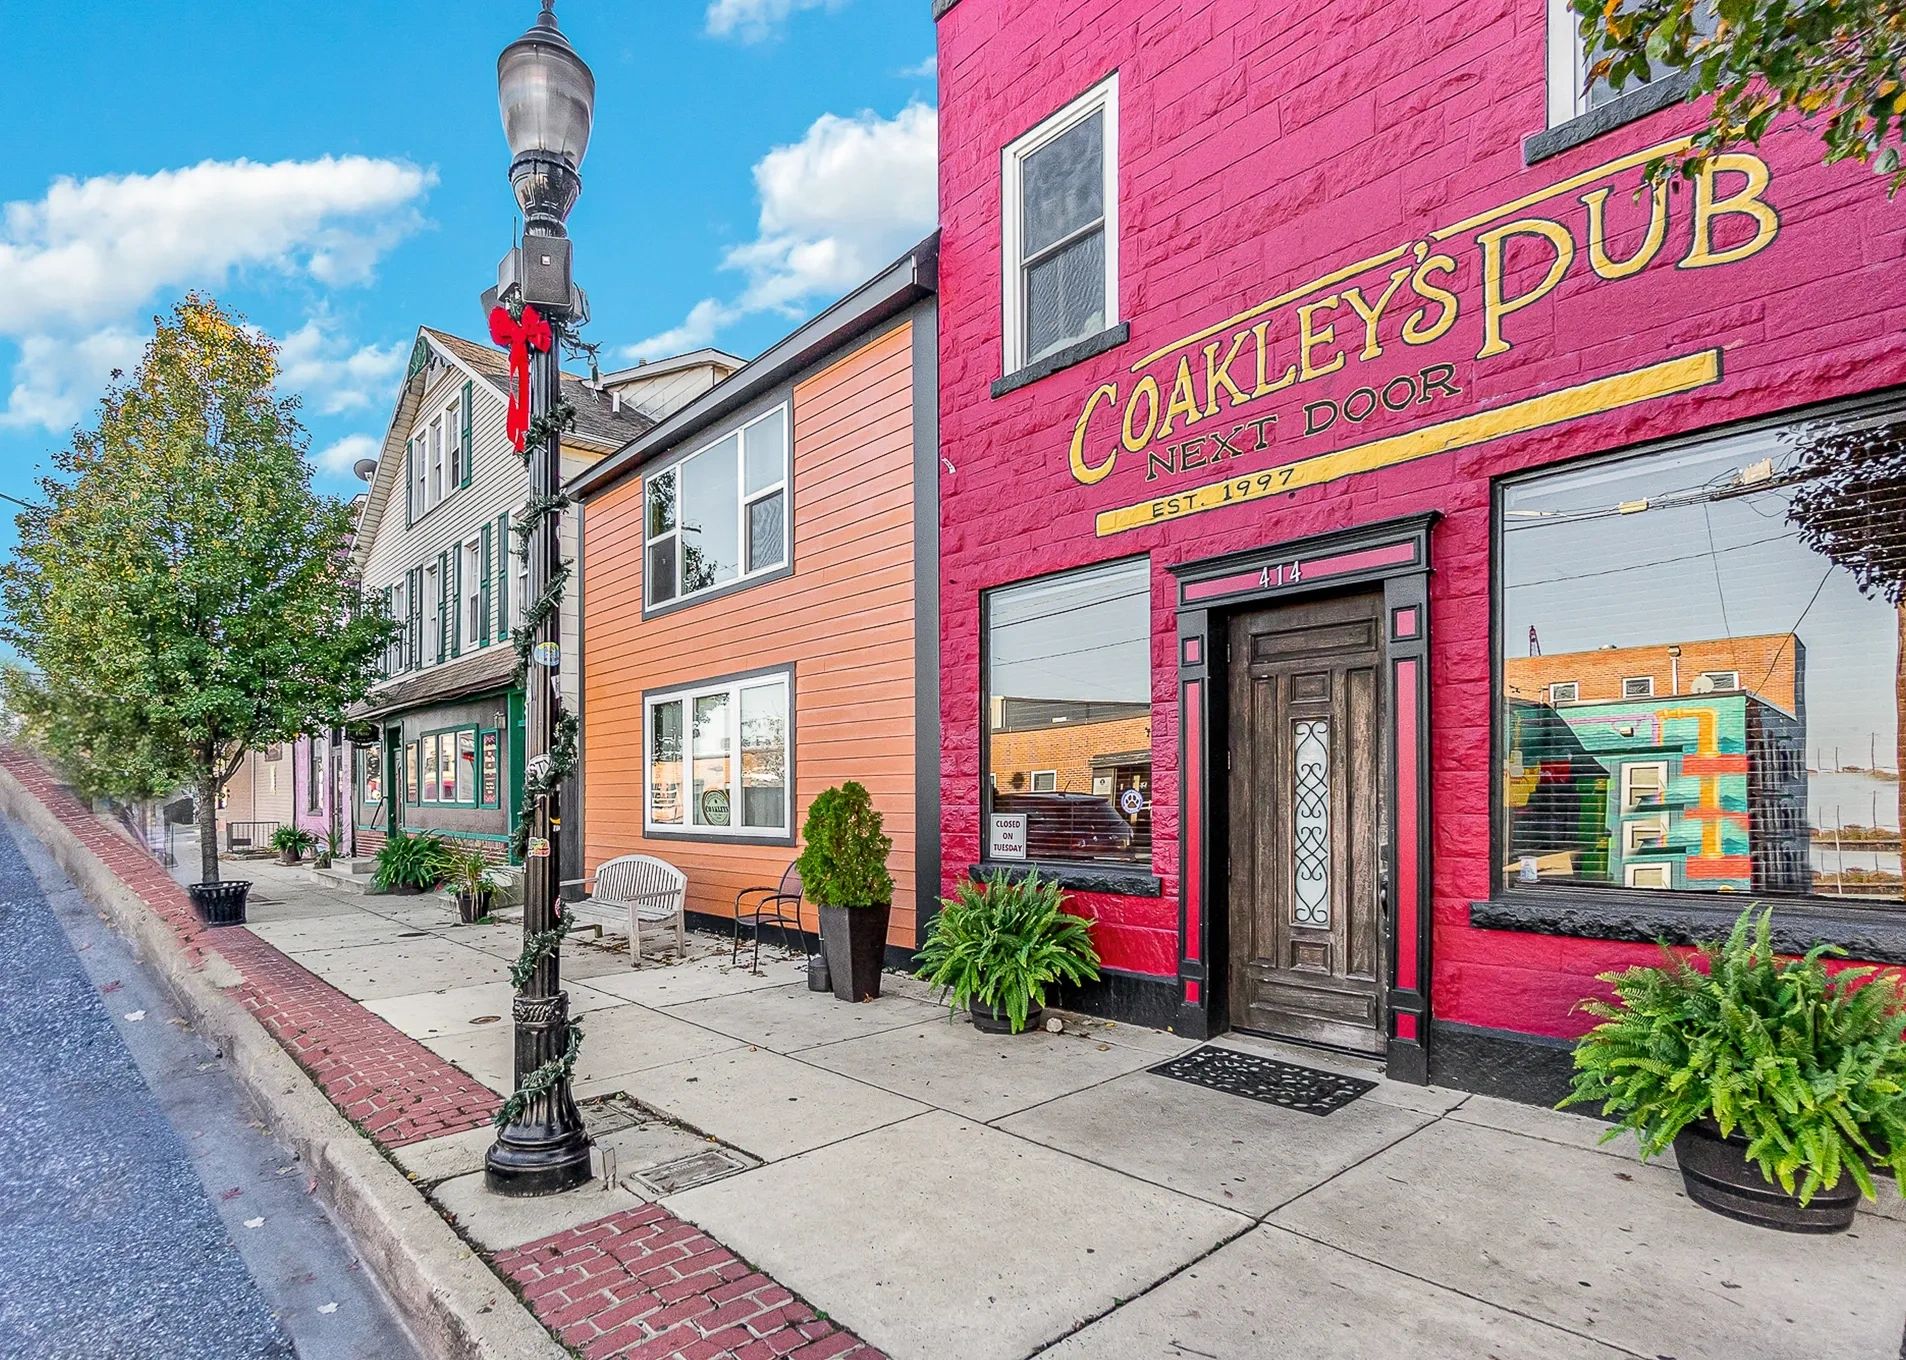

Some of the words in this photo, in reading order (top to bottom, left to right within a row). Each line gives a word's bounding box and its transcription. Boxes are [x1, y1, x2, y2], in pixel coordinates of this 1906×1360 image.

[1068, 239, 1461, 486] COAKLEY'S
[1475, 152, 1781, 361] PUB
[1145, 415, 1278, 482] NEXT
[1302, 362, 1463, 437] DOOR
[1151, 492, 1206, 519] EST.
[1222, 467, 1295, 502] 1997
[1258, 560, 1302, 588] 414
[995, 820, 1021, 829] CLOSED
[1002, 832, 1014, 840] ON
[993, 843, 1023, 852] TUESDAY
